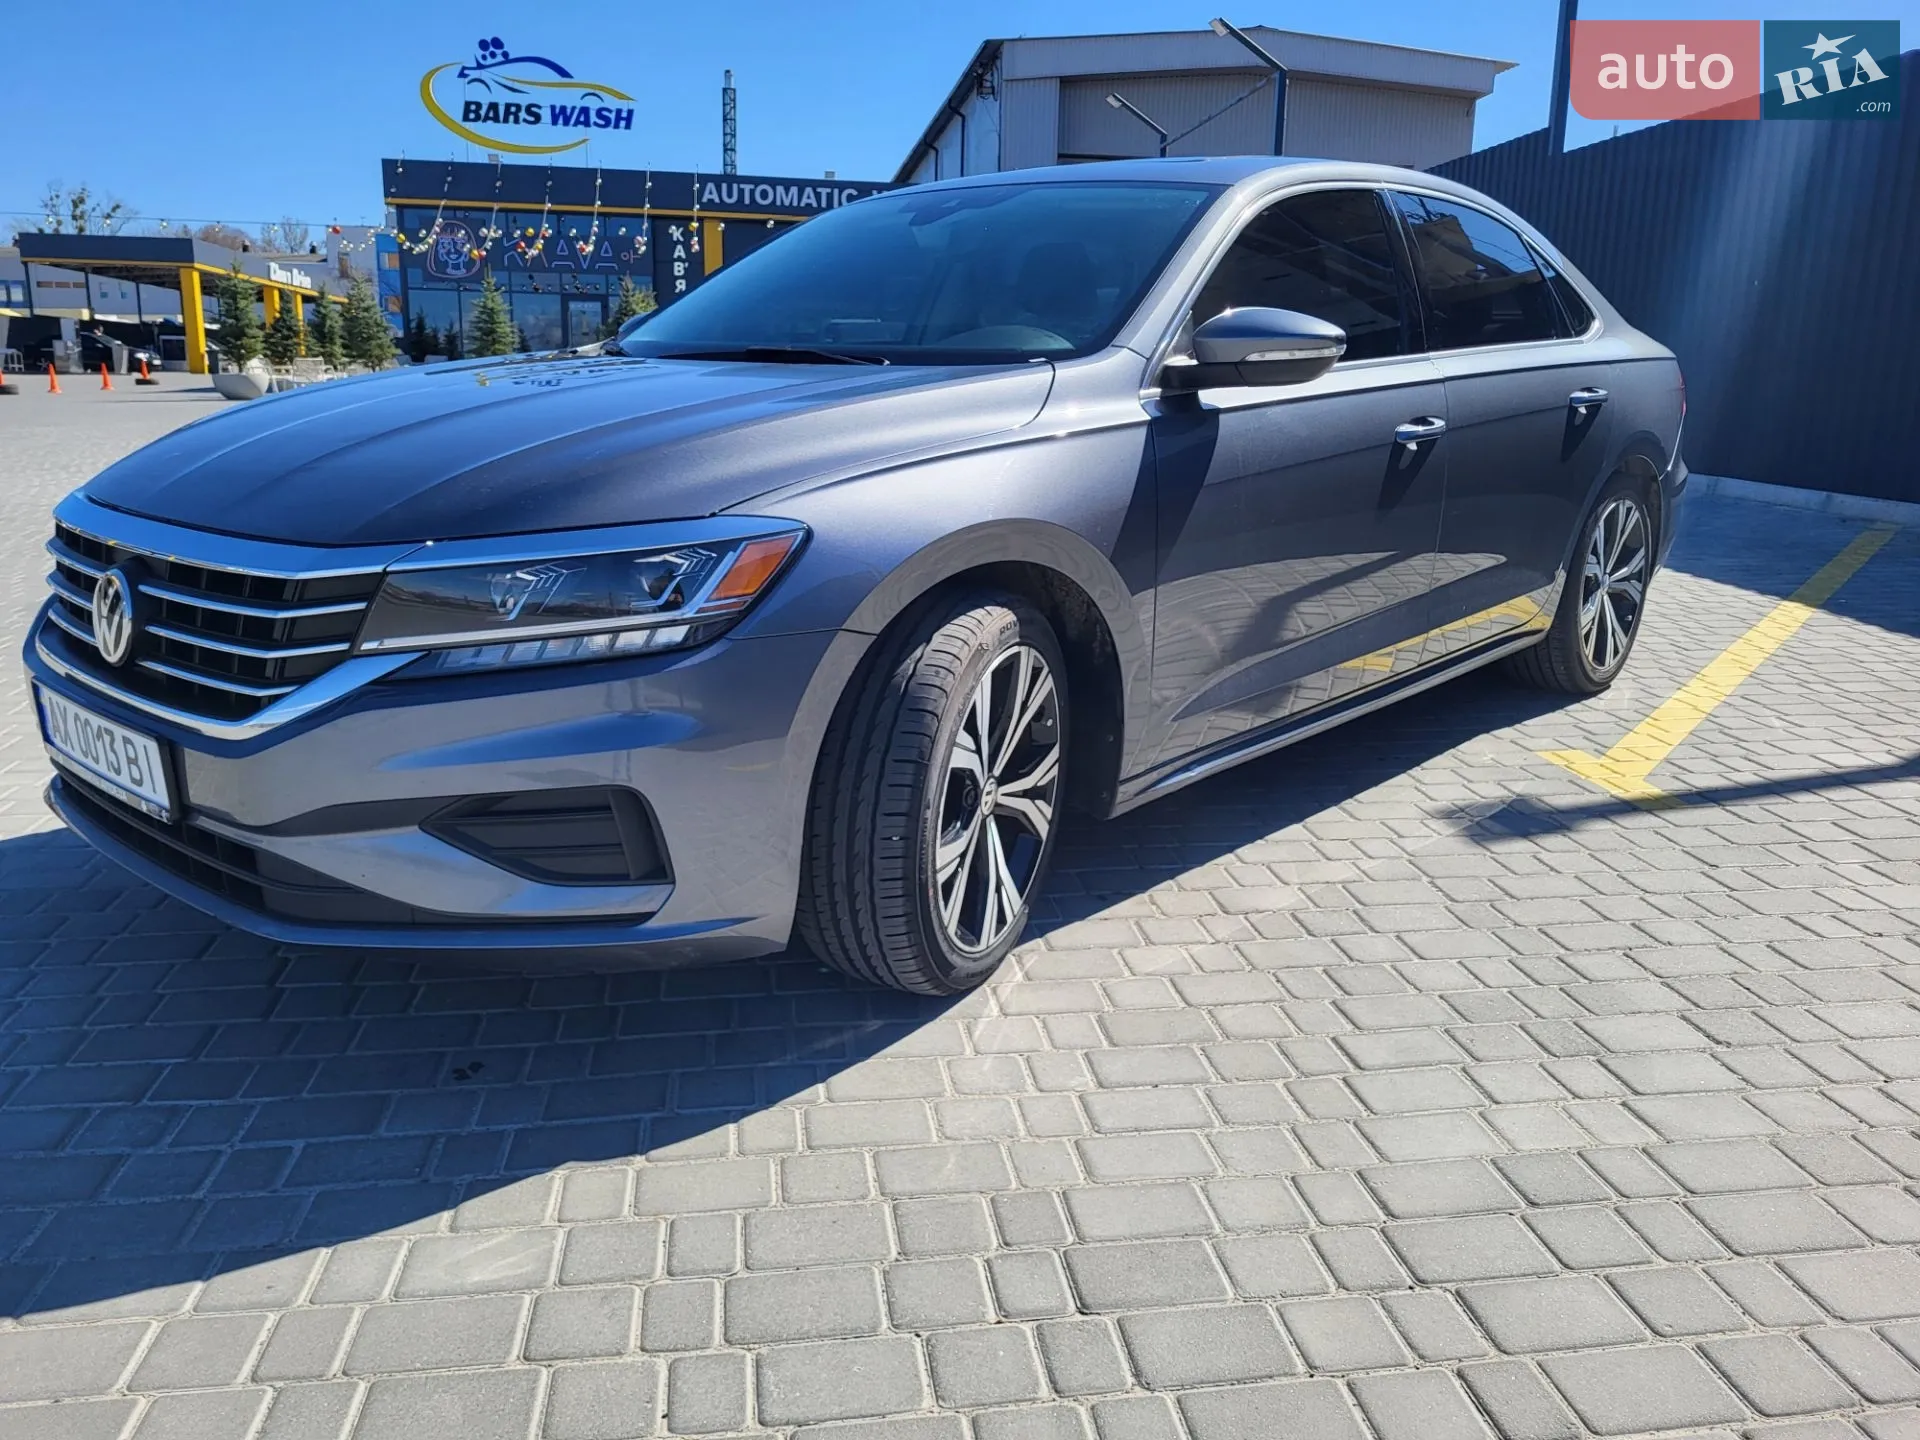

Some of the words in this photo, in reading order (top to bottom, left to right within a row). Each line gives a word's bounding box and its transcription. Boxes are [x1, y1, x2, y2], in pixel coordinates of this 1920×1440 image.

[462, 100, 542, 126] BARS
[549, 104, 635, 131] WASH
[701, 181, 859, 210] AUTOMATIC
[49, 696, 76, 753] AX
[74, 711, 122, 777] 0013
[122, 735, 158, 795] BI
